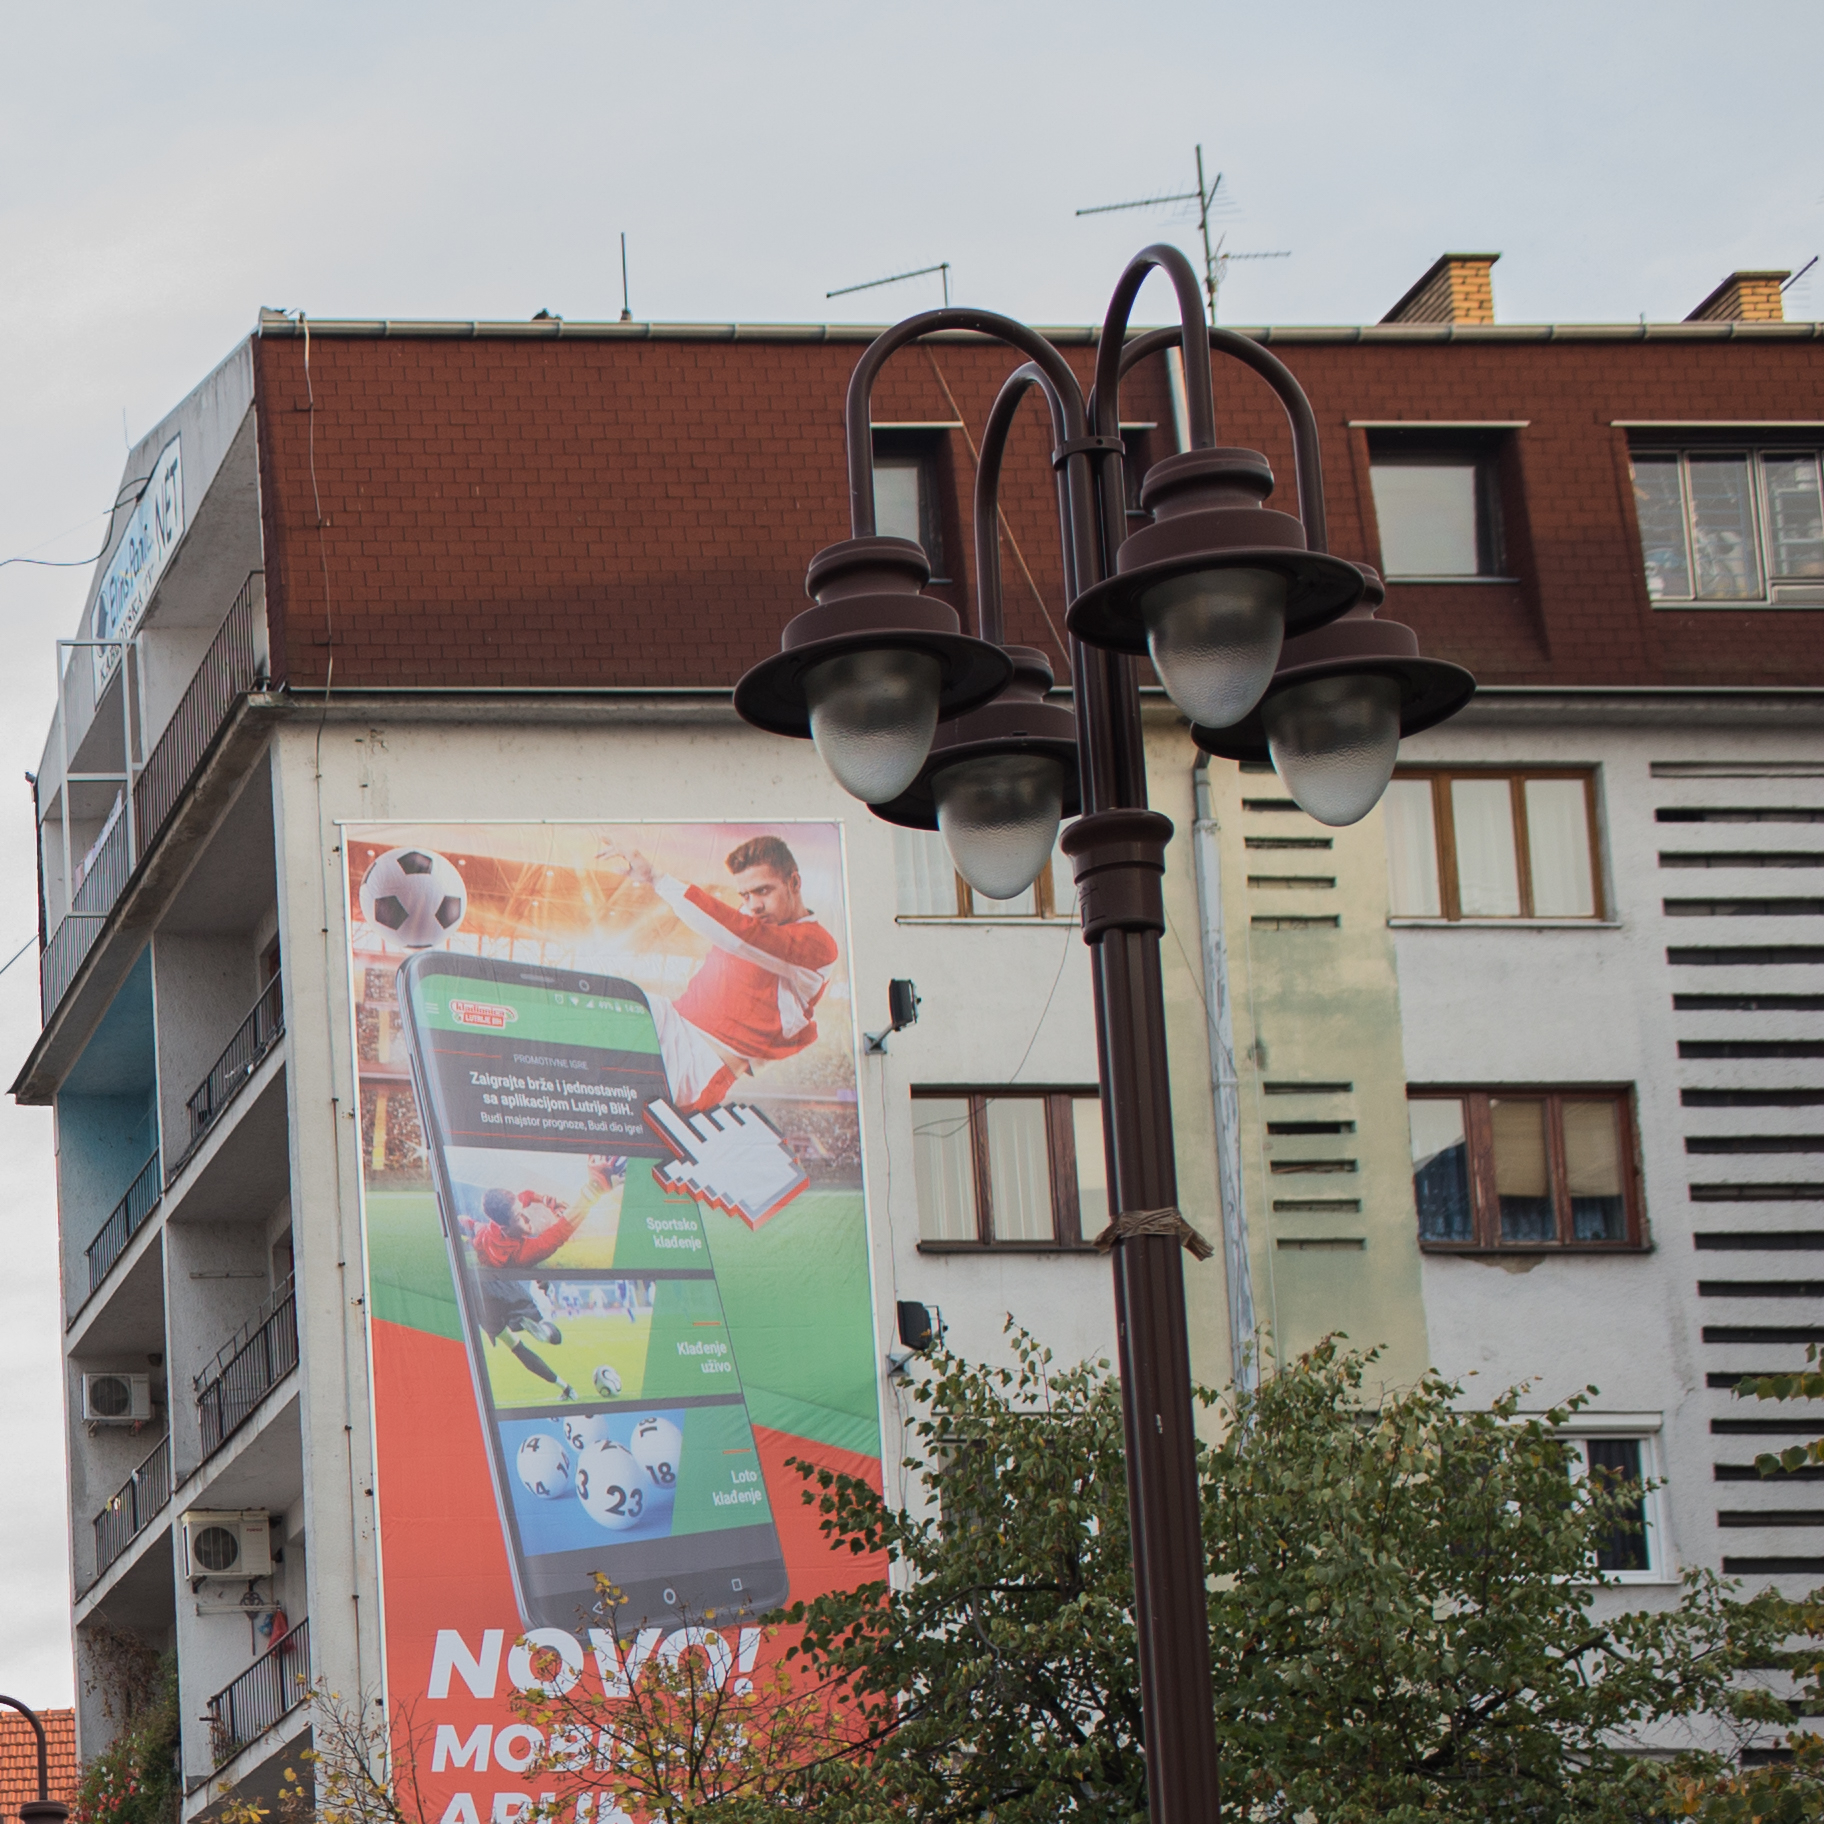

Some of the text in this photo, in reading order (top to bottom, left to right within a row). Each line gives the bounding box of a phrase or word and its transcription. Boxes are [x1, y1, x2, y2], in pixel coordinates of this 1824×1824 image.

[155, 456, 178, 562] NET
[513, 1053, 589, 1070] PROMOTIVNE IGRE
[469, 1071, 526, 1091] Zaigrajte
[526, 1076, 555, 1092] brže
[561, 1079, 638, 1101] jednostavnije
[482, 1093, 634, 1117] sa aplikacijom Lutrije BiH.
[480, 1112, 503, 1124] Budi
[504, 1114, 541, 1128] majstor
[542, 1118, 588, 1131] prognoze,
[587, 1120, 608, 1132] Budi
[609, 1121, 624, 1133] dio
[646, 1217, 698, 1232] Sportsko
[653, 1235, 702, 1251] klađenje
[677, 1341, 728, 1357] Klađenje
[700, 1359, 732, 1373] uživo
[645, 1462, 676, 1486] 18
[730, 1469, 758, 1484] Loto
[605, 1484, 643, 1518] 23
[713, 1488, 763, 1506] klađenje
[427, 1626, 762, 1699] NOVO!
